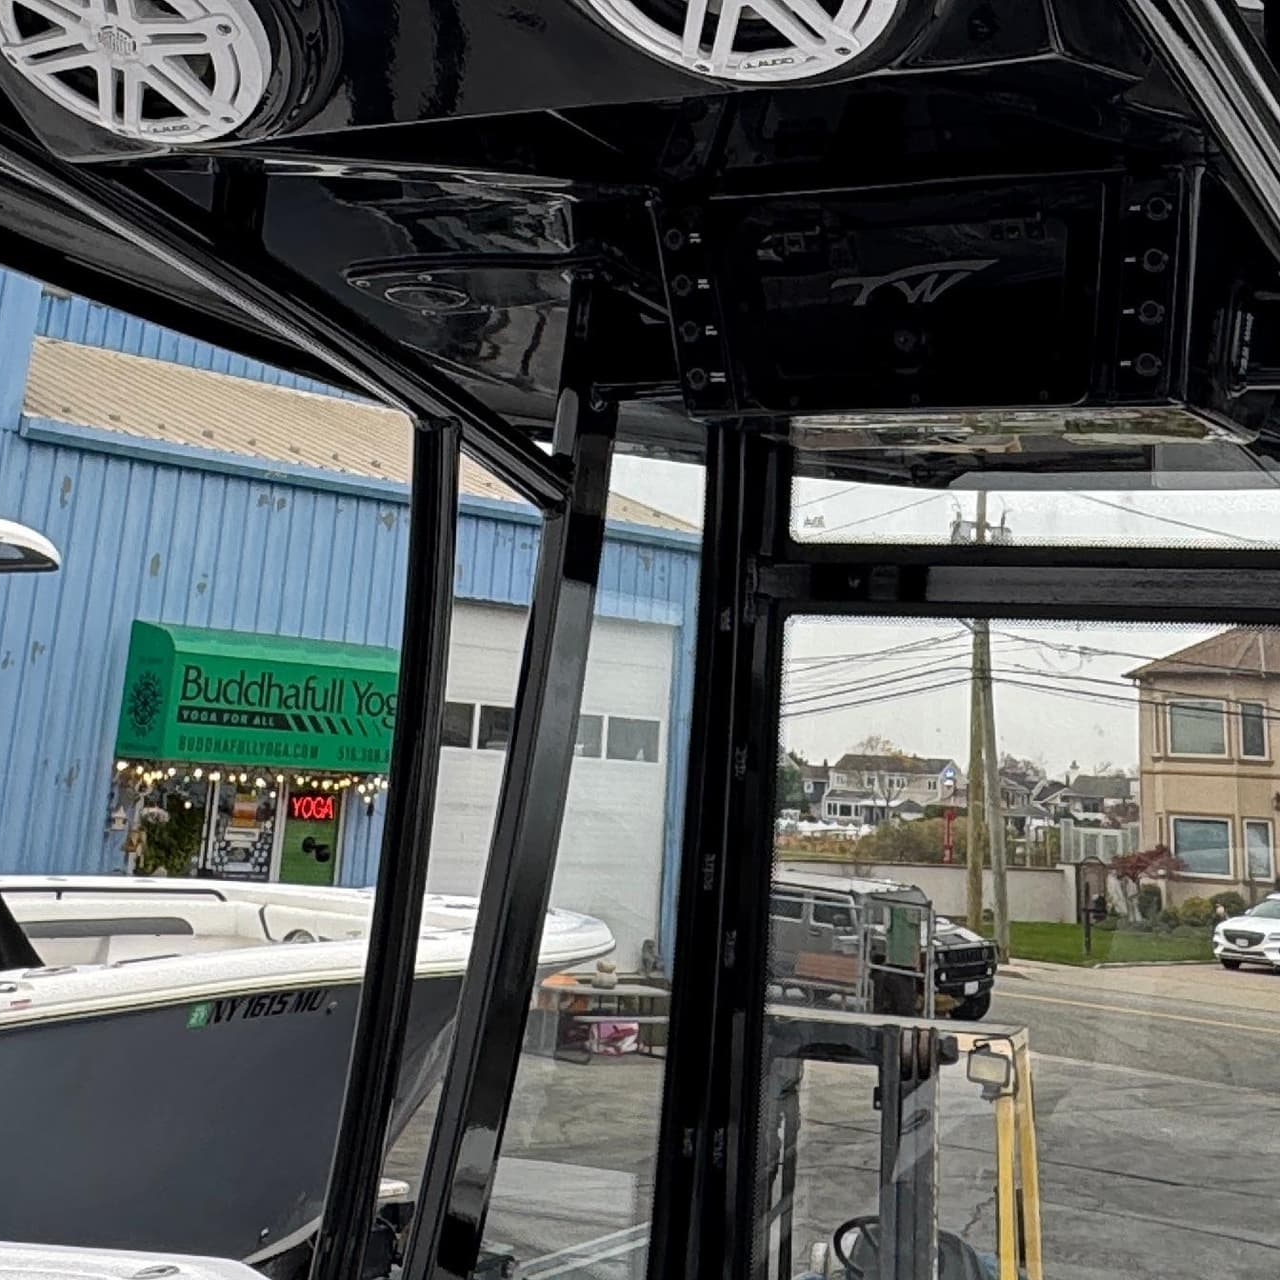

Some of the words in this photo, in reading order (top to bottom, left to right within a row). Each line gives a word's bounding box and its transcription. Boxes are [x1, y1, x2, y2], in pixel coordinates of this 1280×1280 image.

[180, 664, 345, 714] Buddhafull
[352, 680, 397, 729] Yog
[181, 709, 218, 722] YOGA
[222, 713, 249, 725] FOR
[252, 715, 276, 727] ALL
[291, 796, 334, 819] YOGA
